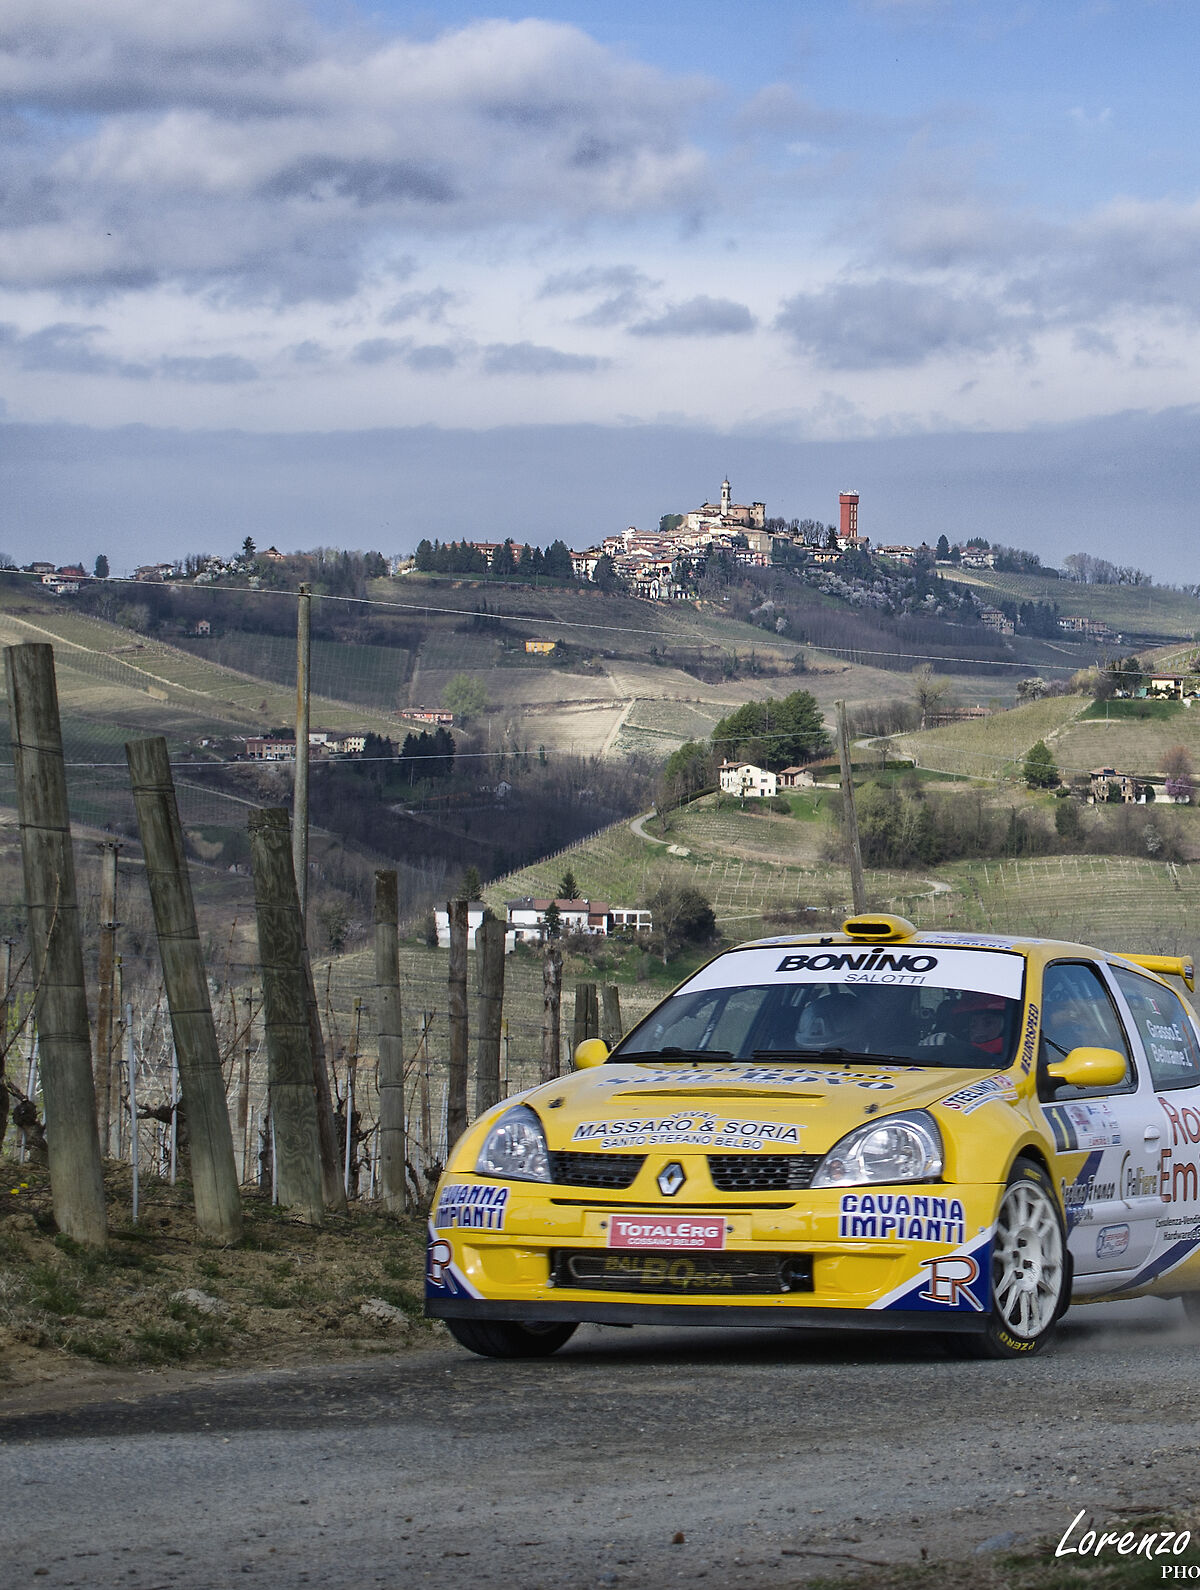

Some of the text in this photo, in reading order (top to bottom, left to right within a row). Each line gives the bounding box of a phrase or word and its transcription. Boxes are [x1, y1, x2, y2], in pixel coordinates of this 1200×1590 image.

[844, 973, 926, 984] SALOTTI
[1022, 1003, 1039, 1069] EUROSPEED
[575, 1119, 800, 1143] MASSARO & SORIA
[1051, 1107, 1070, 1149] 1
[601, 1134, 764, 1150] SANTO STEFANO BELBO
[434, 1206, 505, 1230] IMPIANTI
[841, 1195, 965, 1221] CAVANNA
[840, 1215, 965, 1244] IMPIANTI
